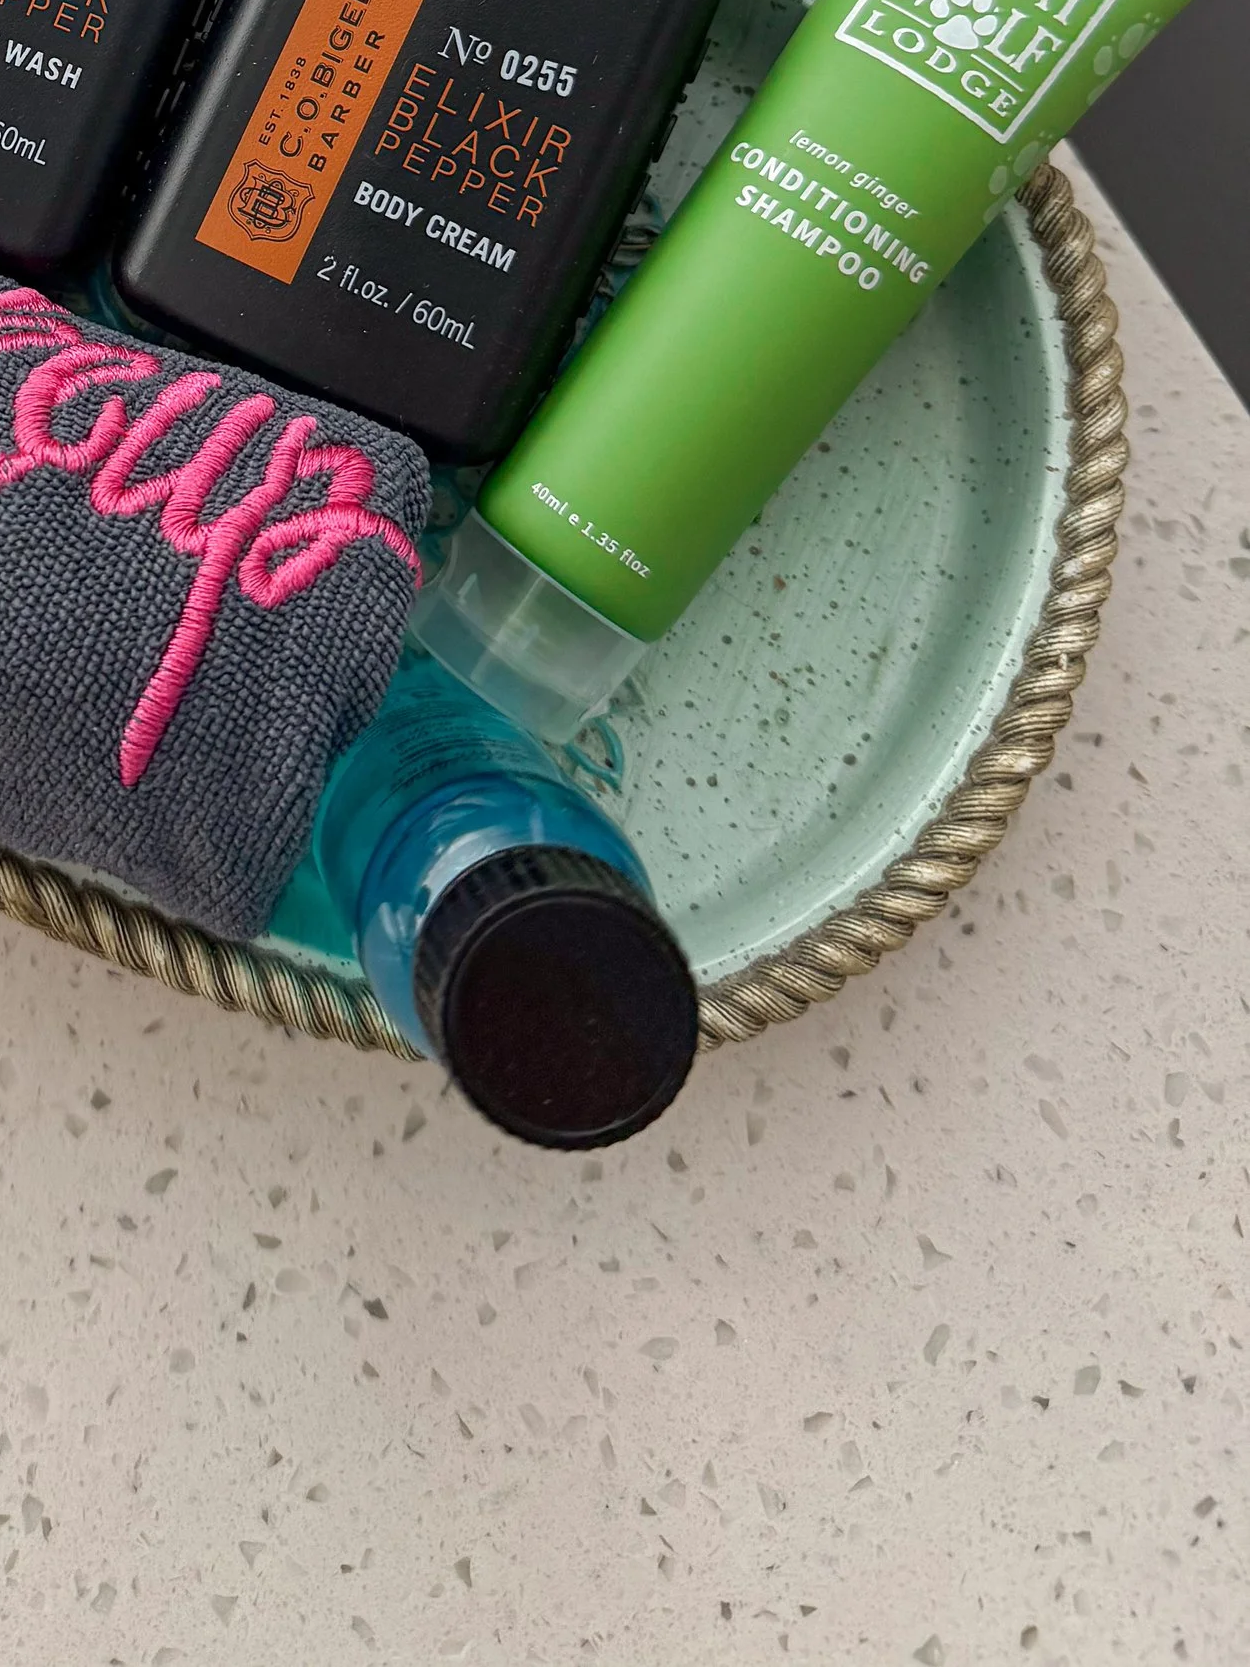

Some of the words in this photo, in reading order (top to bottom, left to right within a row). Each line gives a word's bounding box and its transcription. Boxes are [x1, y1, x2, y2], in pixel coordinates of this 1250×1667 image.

[4, 39, 84, 90] WASH
[258, 108, 283, 147] EST.
[280, 56, 306, 101] 1838
[307, 29, 385, 172] BARBER
[500, 49, 578, 97] 0255
[860, 10, 1017, 117] LODGE
[388, 97, 558, 198] BLACK
[403, 63, 572, 163] ELIXIR
[374, 130, 544, 227] PEPPER
[730, 142, 929, 283] CONDITIONING
[789, 129, 852, 174] lemon
[849, 171, 919, 220] ginger
[353, 181, 424, 227] BODY
[426, 214, 517, 272] CREAM
[735, 185, 880, 290] SHAMPOO
[317, 255, 336, 281] 2
[412, 300, 475, 350] 60mL
[531, 482, 568, 515] 40ml
[581, 521, 619, 553] 1.35
